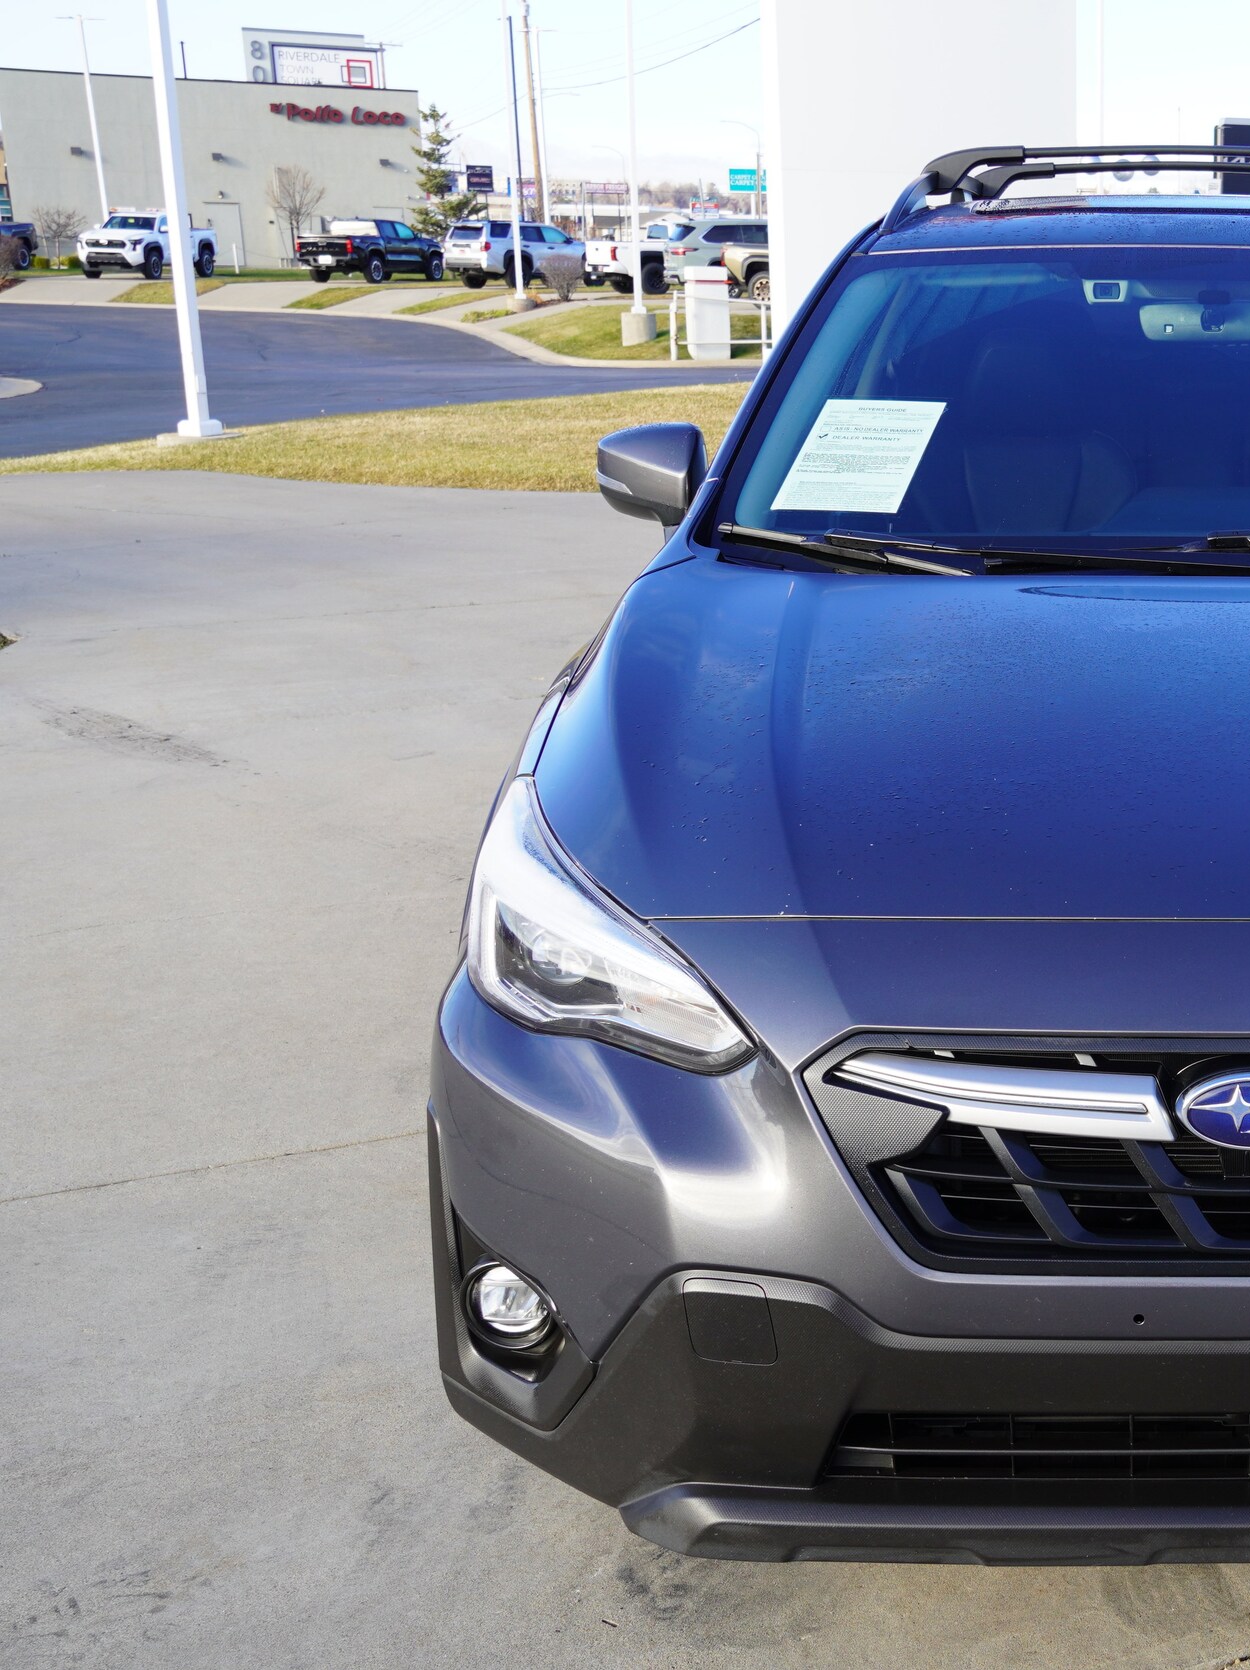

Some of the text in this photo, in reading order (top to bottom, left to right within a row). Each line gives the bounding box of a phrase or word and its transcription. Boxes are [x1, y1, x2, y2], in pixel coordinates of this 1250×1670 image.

[250, 40, 263, 60] 8
[278, 50, 340, 64] RIVERDALE
[279, 64, 315, 75] TOWN
[286, 103, 344, 123] Pollo
[351, 106, 405, 126] Loco
